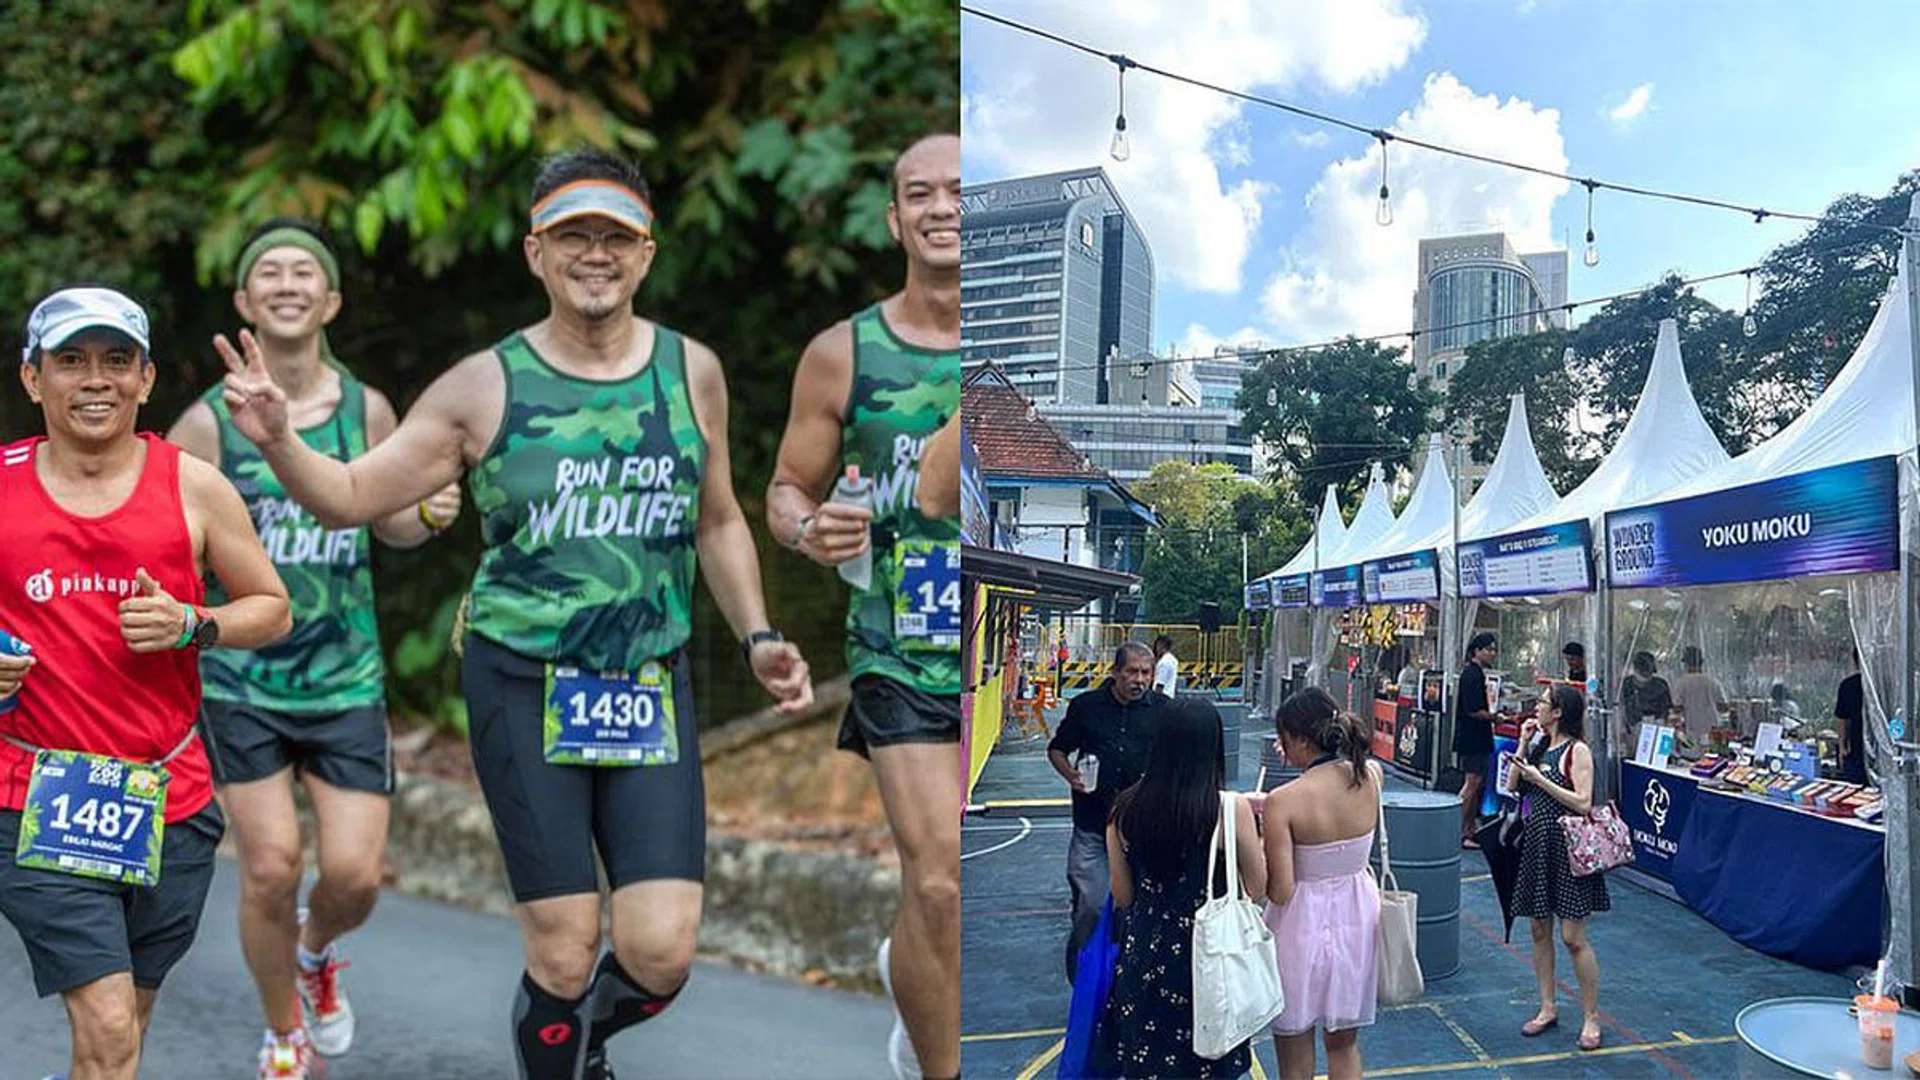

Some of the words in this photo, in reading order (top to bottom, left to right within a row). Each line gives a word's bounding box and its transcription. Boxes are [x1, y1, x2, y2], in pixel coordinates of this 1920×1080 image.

[893, 434, 926, 467] RU
[556, 456, 611, 493] RUN
[619, 455, 675, 491] FOR
[527, 490, 691, 546] WILDLIFE
[1702, 522, 1749, 548] YOKU
[1751, 512, 1811, 542] MOKU
[260, 523, 360, 566] ILDLIF
[60, 572, 141, 597] pinkapp
[917, 581, 960, 613] 14
[569, 690, 655, 728] 1430
[49, 793, 145, 841] 1487
